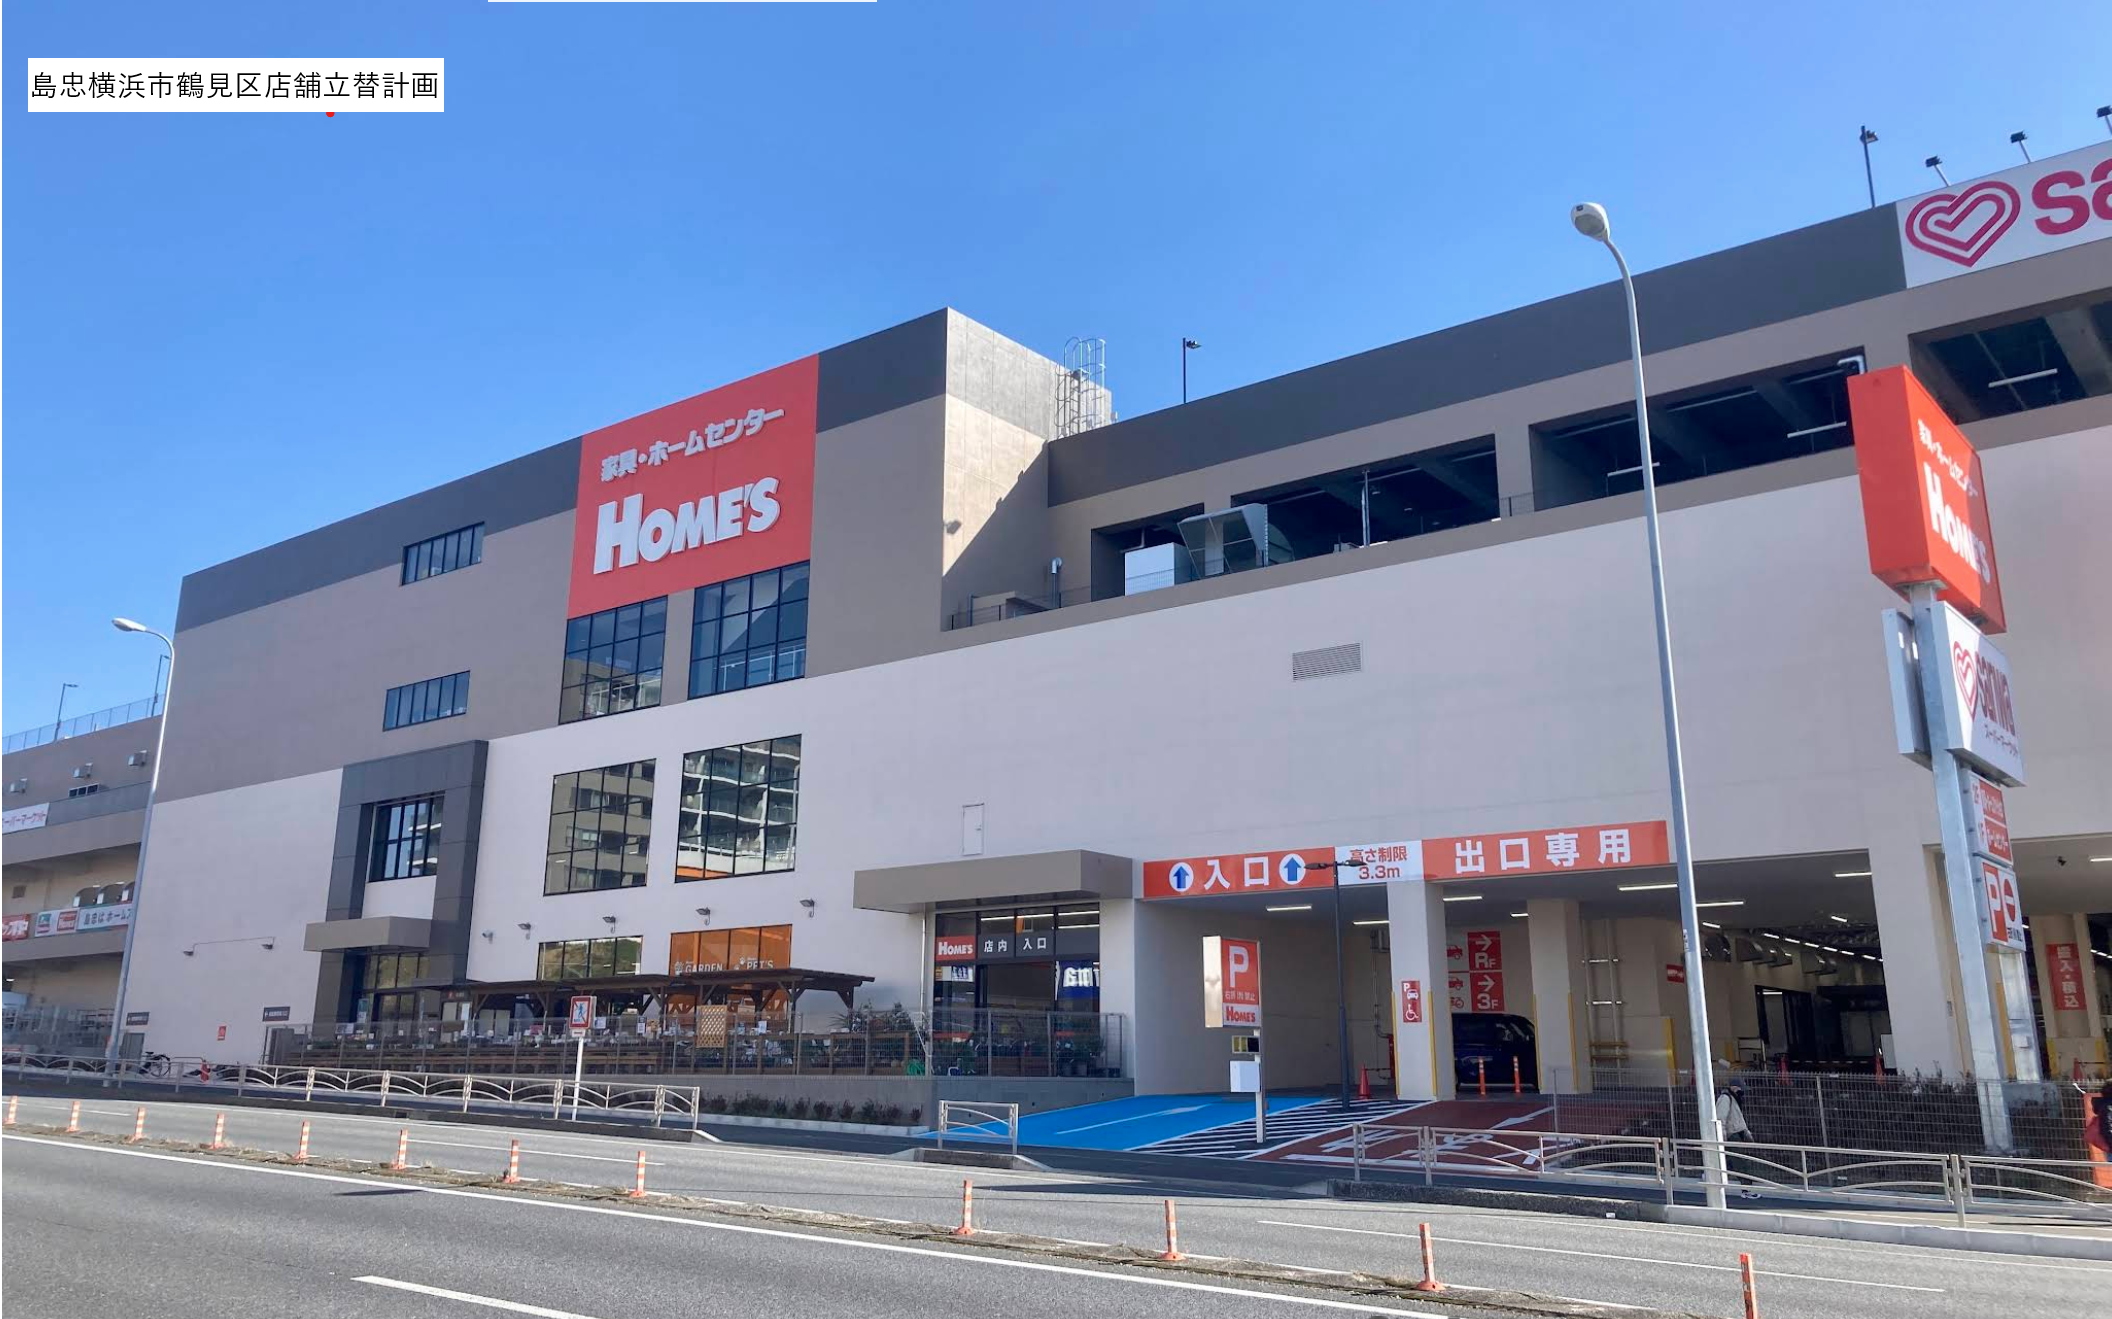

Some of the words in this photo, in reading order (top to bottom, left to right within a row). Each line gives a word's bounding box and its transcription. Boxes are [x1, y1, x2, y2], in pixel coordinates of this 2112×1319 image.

[601, 408, 785, 482] 家具・ホームセンター
[594, 477, 780, 575] HOME'S
[1350, 846, 1407, 863] 高さ制限
[1455, 828, 1631, 874] 出口専用
[1203, 856, 1270, 890] 入口
[1358, 865, 1400, 880] 3.3m
[938, 941, 973, 956] HOME'S
[1229, 945, 1249, 987] P
